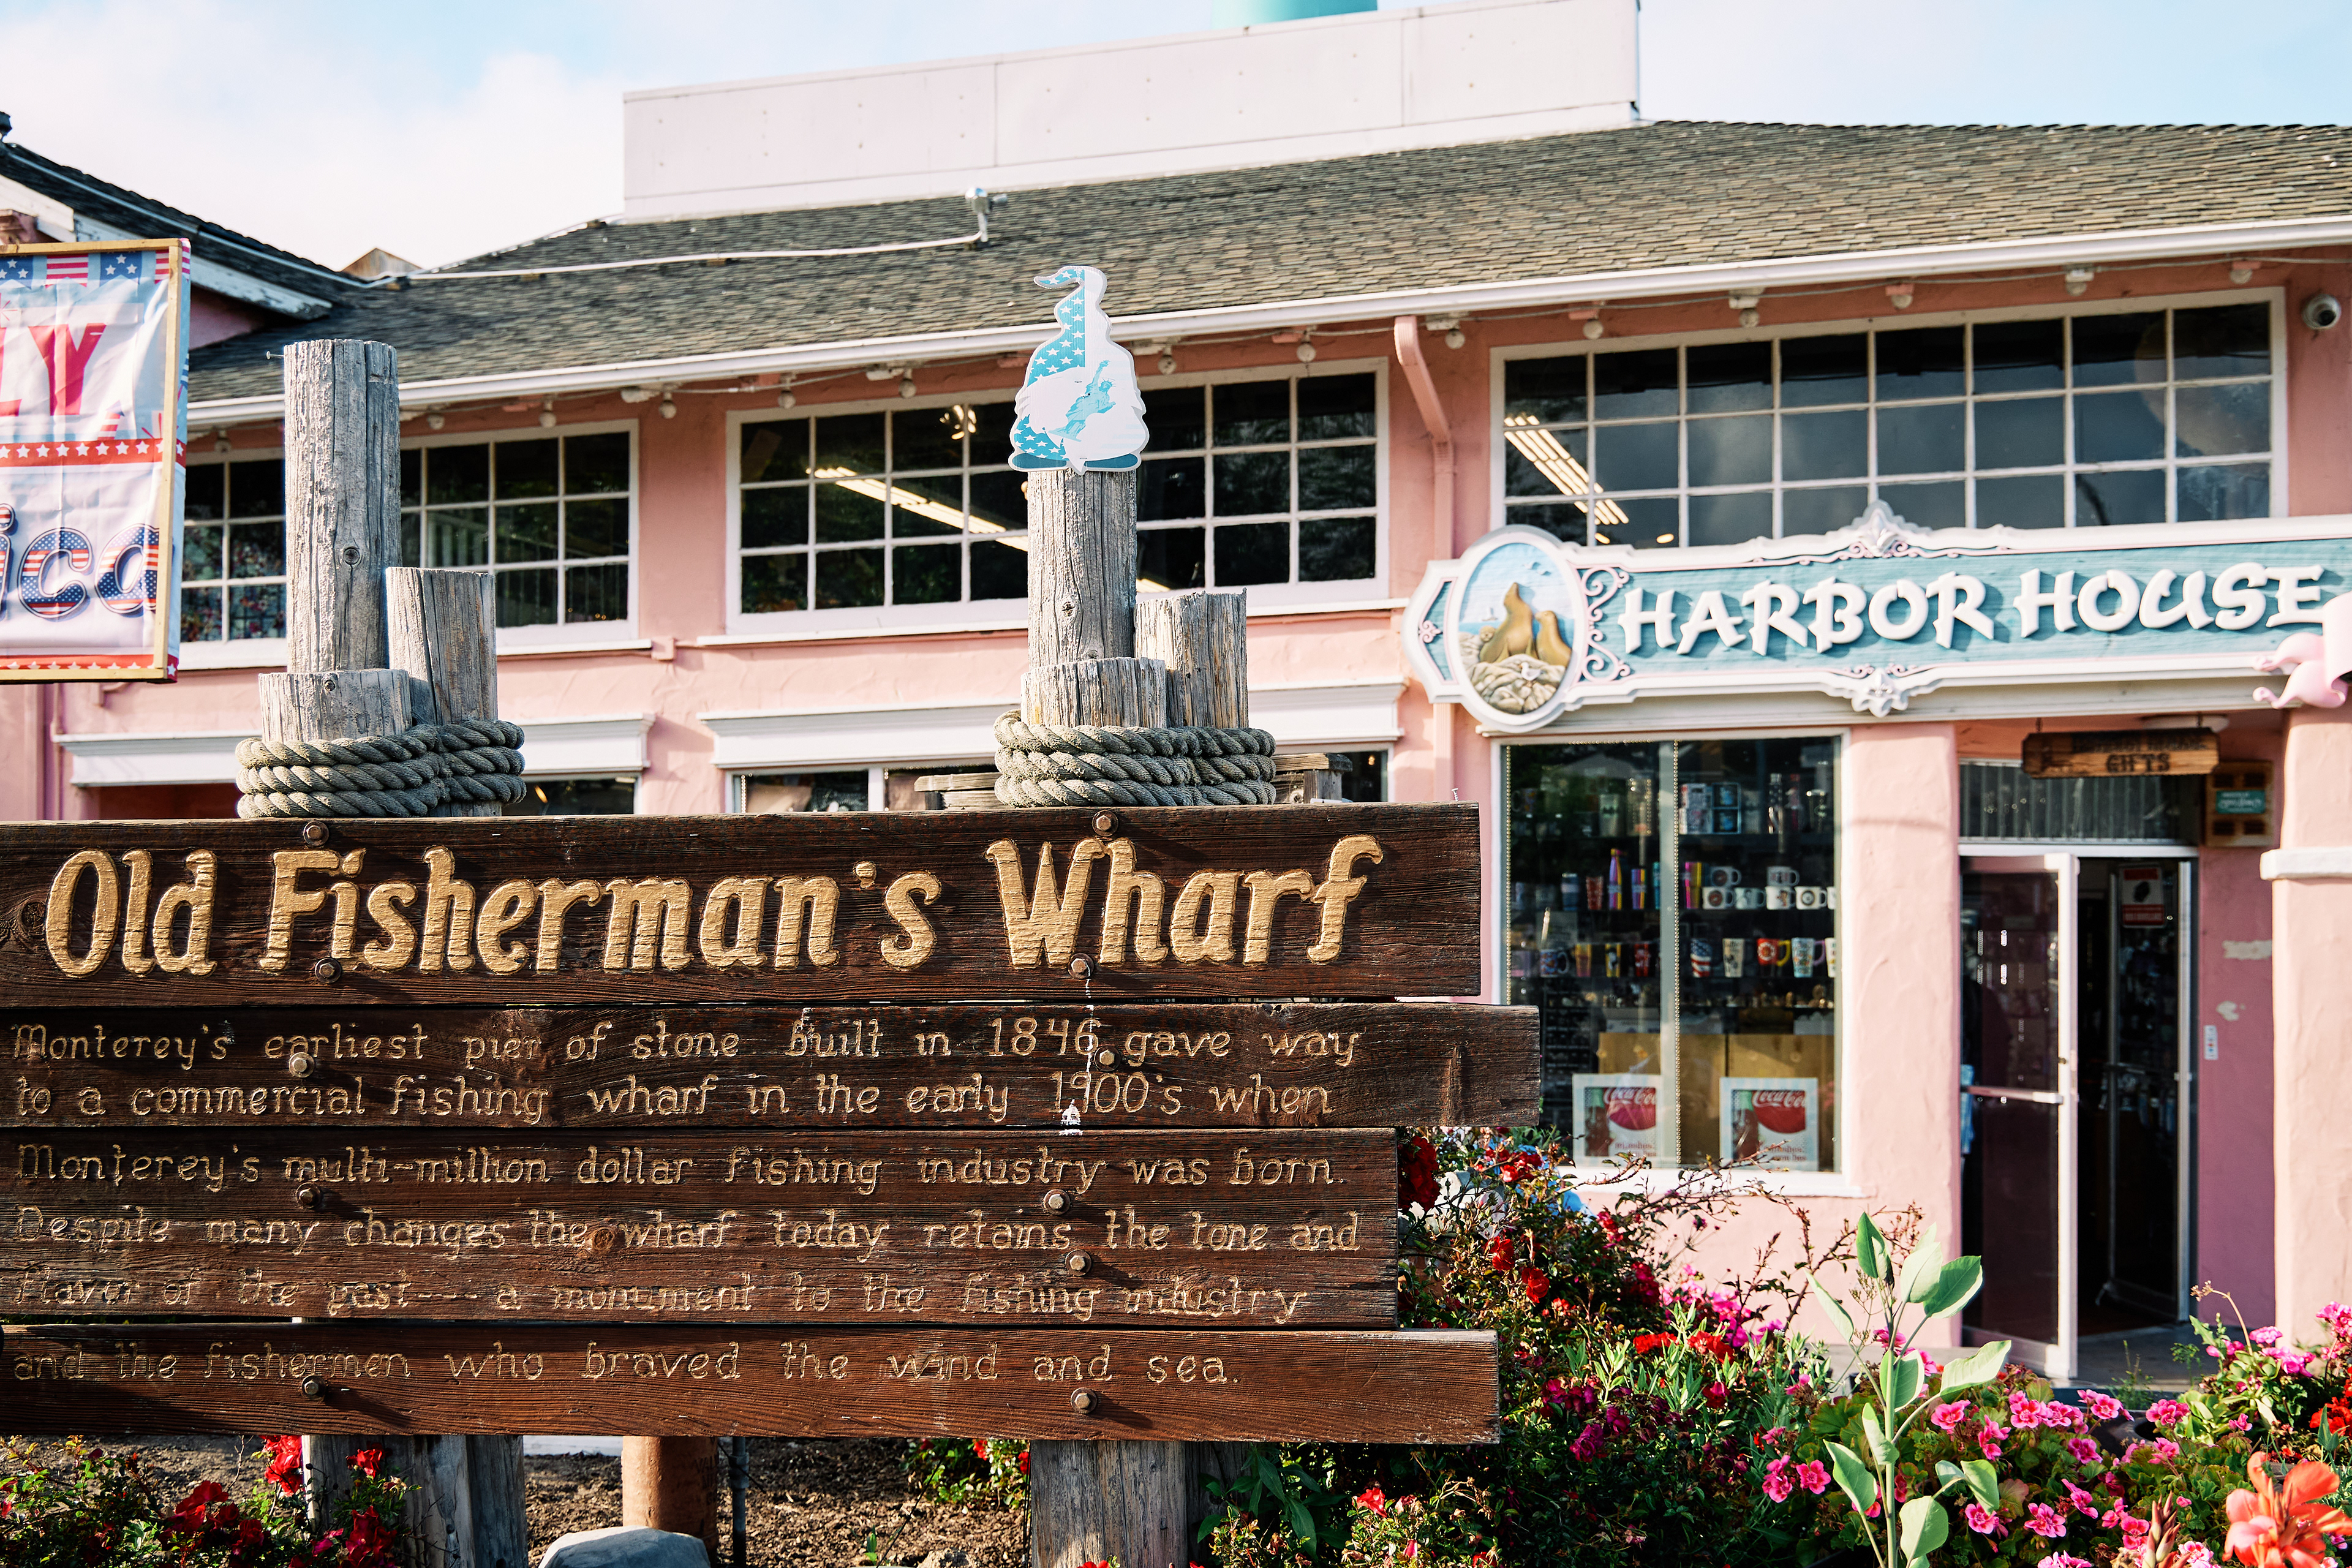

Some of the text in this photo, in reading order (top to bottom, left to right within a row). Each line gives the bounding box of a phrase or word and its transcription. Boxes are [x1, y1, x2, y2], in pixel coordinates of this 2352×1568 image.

[1618, 562, 2324, 656] HARBOR HOUSE
[2105, 753, 2171, 773] GIFTS
[45, 834, 1384, 978] Old Fisherman's Wharf
[12, 1016, 1359, 1070] Monterey's earliest pier of stone built in 1846 gave way
[17, 1071, 1336, 1125] to a commercial fishing wharf in the early 1900's when
[17, 1144, 1344, 1196] Monterey's multi-million dollar fishing industry was born.
[15, 1204, 1361, 1263] Despite many changes the wharf today retains the tone and
[162, 1267, 201, 1306] of
[237, 1267, 300, 1307] the
[495, 1281, 522, 1311] a
[550, 1272, 755, 1311] monument
[794, 1272, 831, 1311] to
[863, 1272, 925, 1313] the
[957, 1272, 1102, 1322] fishing
[1123, 1274, 1308, 1325] industry
[13, 1340, 1240, 1384] and the fishermen who braved the wind and sea.
